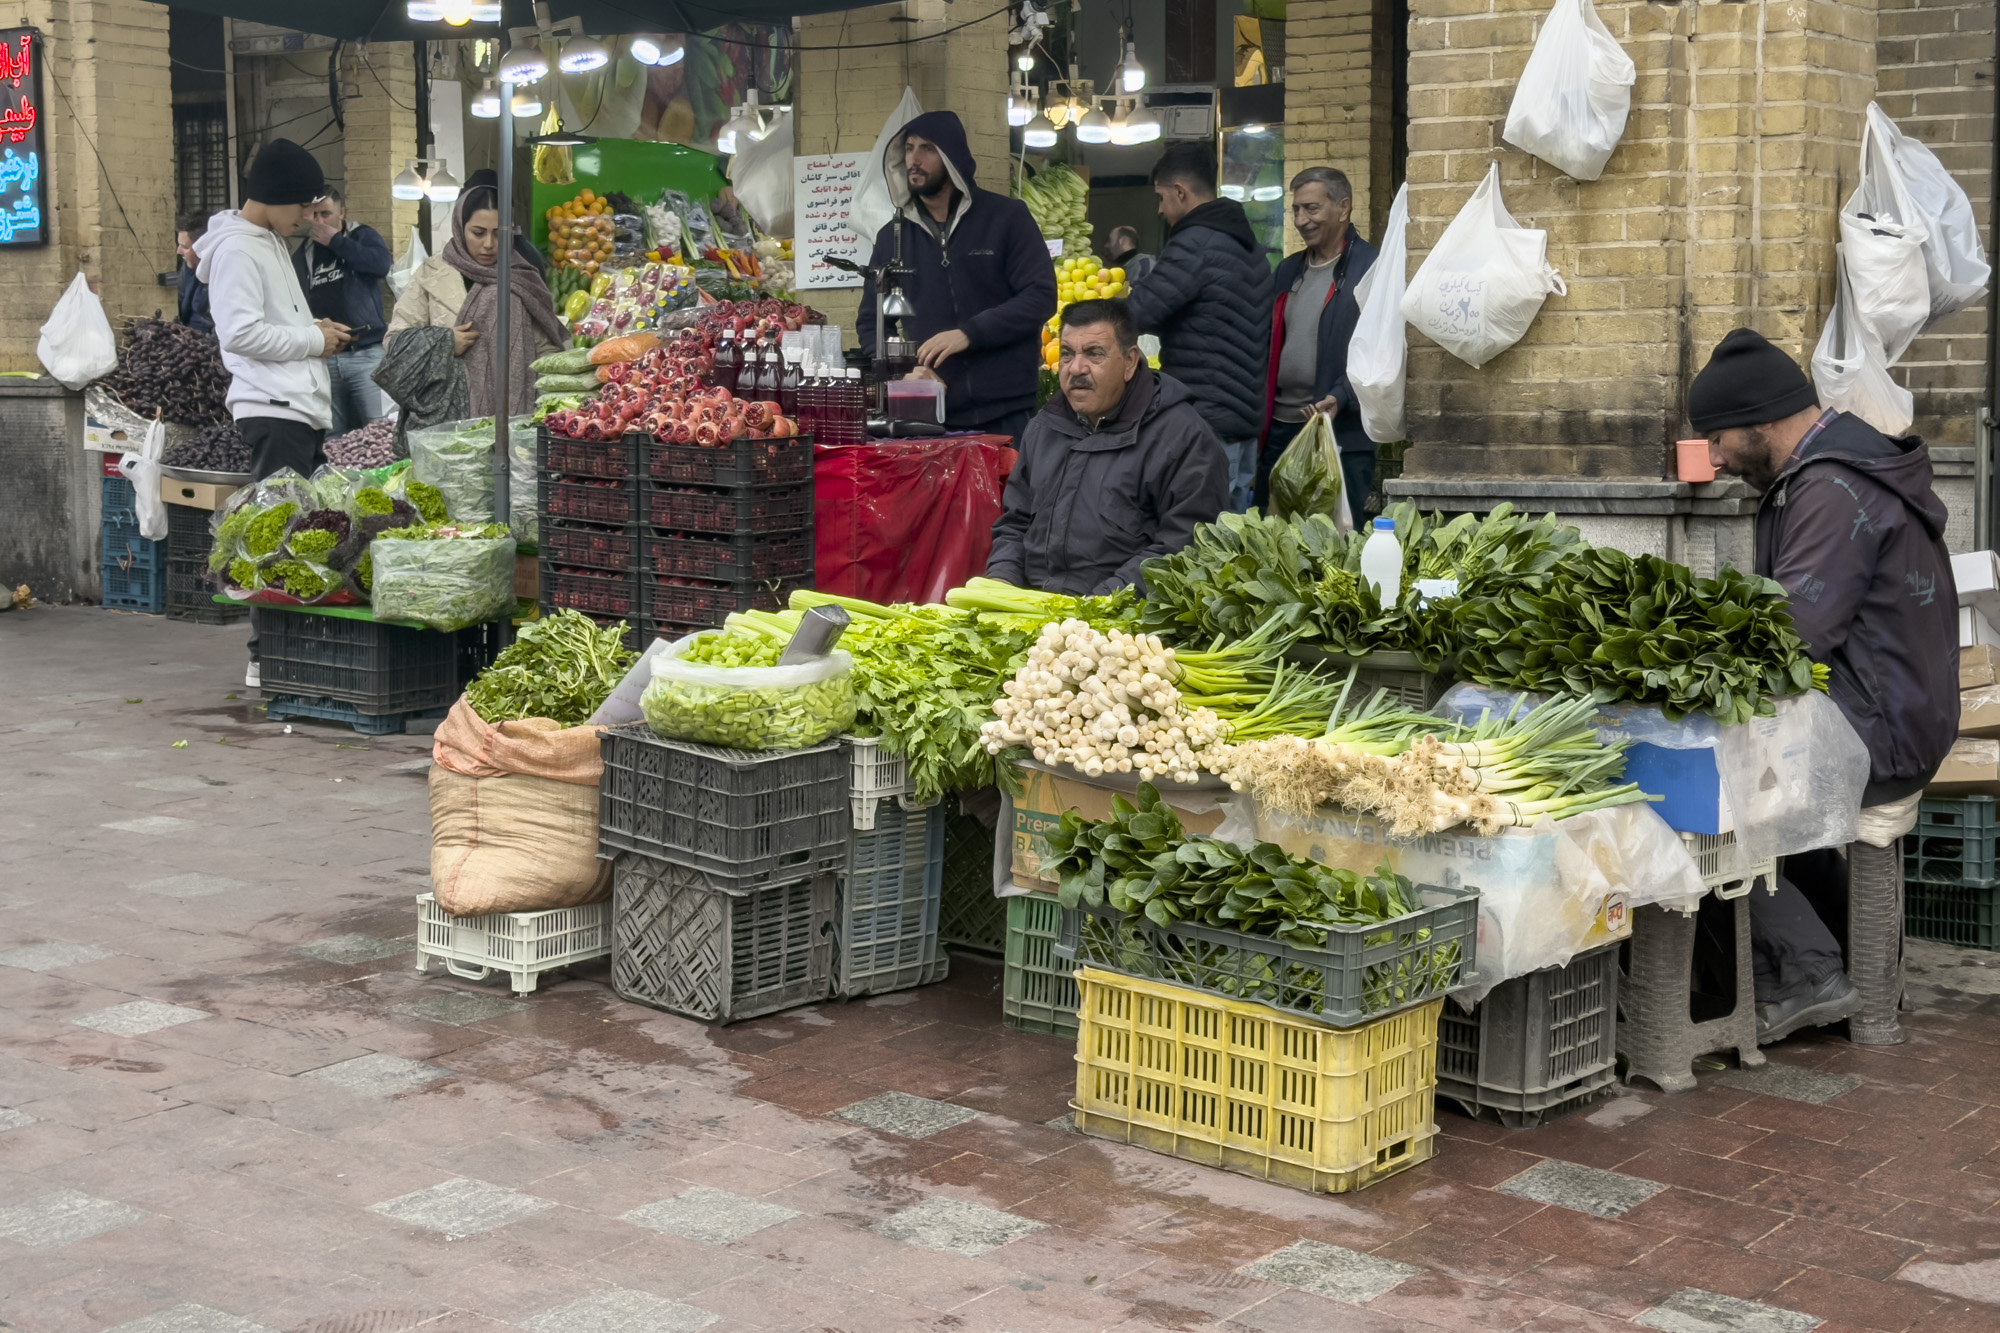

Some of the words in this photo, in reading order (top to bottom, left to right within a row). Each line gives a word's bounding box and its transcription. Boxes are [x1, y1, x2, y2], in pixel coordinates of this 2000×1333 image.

[10, 35, 31, 87] آب
[0, 95, 36, 142] طبیع
[807, 160, 830, 170] اسفناج
[800, 173, 822, 184] کاشان
[824, 174, 837, 182] سبز
[839, 170, 861, 181] اقالی
[833, 184, 852, 194] نخود
[807, 197, 838, 208] فرانسوی
[840, 196, 852, 206] اهو
[805, 211, 820, 219] شده
[822, 210, 838, 220] خرد
[829, 222, 848, 232] قالی
[825, 235, 840, 244] پاک
[841, 234, 858, 244] لوبیا
[808, 248, 838, 258] مکزیکی
[840, 246, 858, 256] ذرت
[808, 273, 835, 283] خوردن
[837, 273, 859, 281] سبزی
[1016, 835, 1053, 857] BAN
